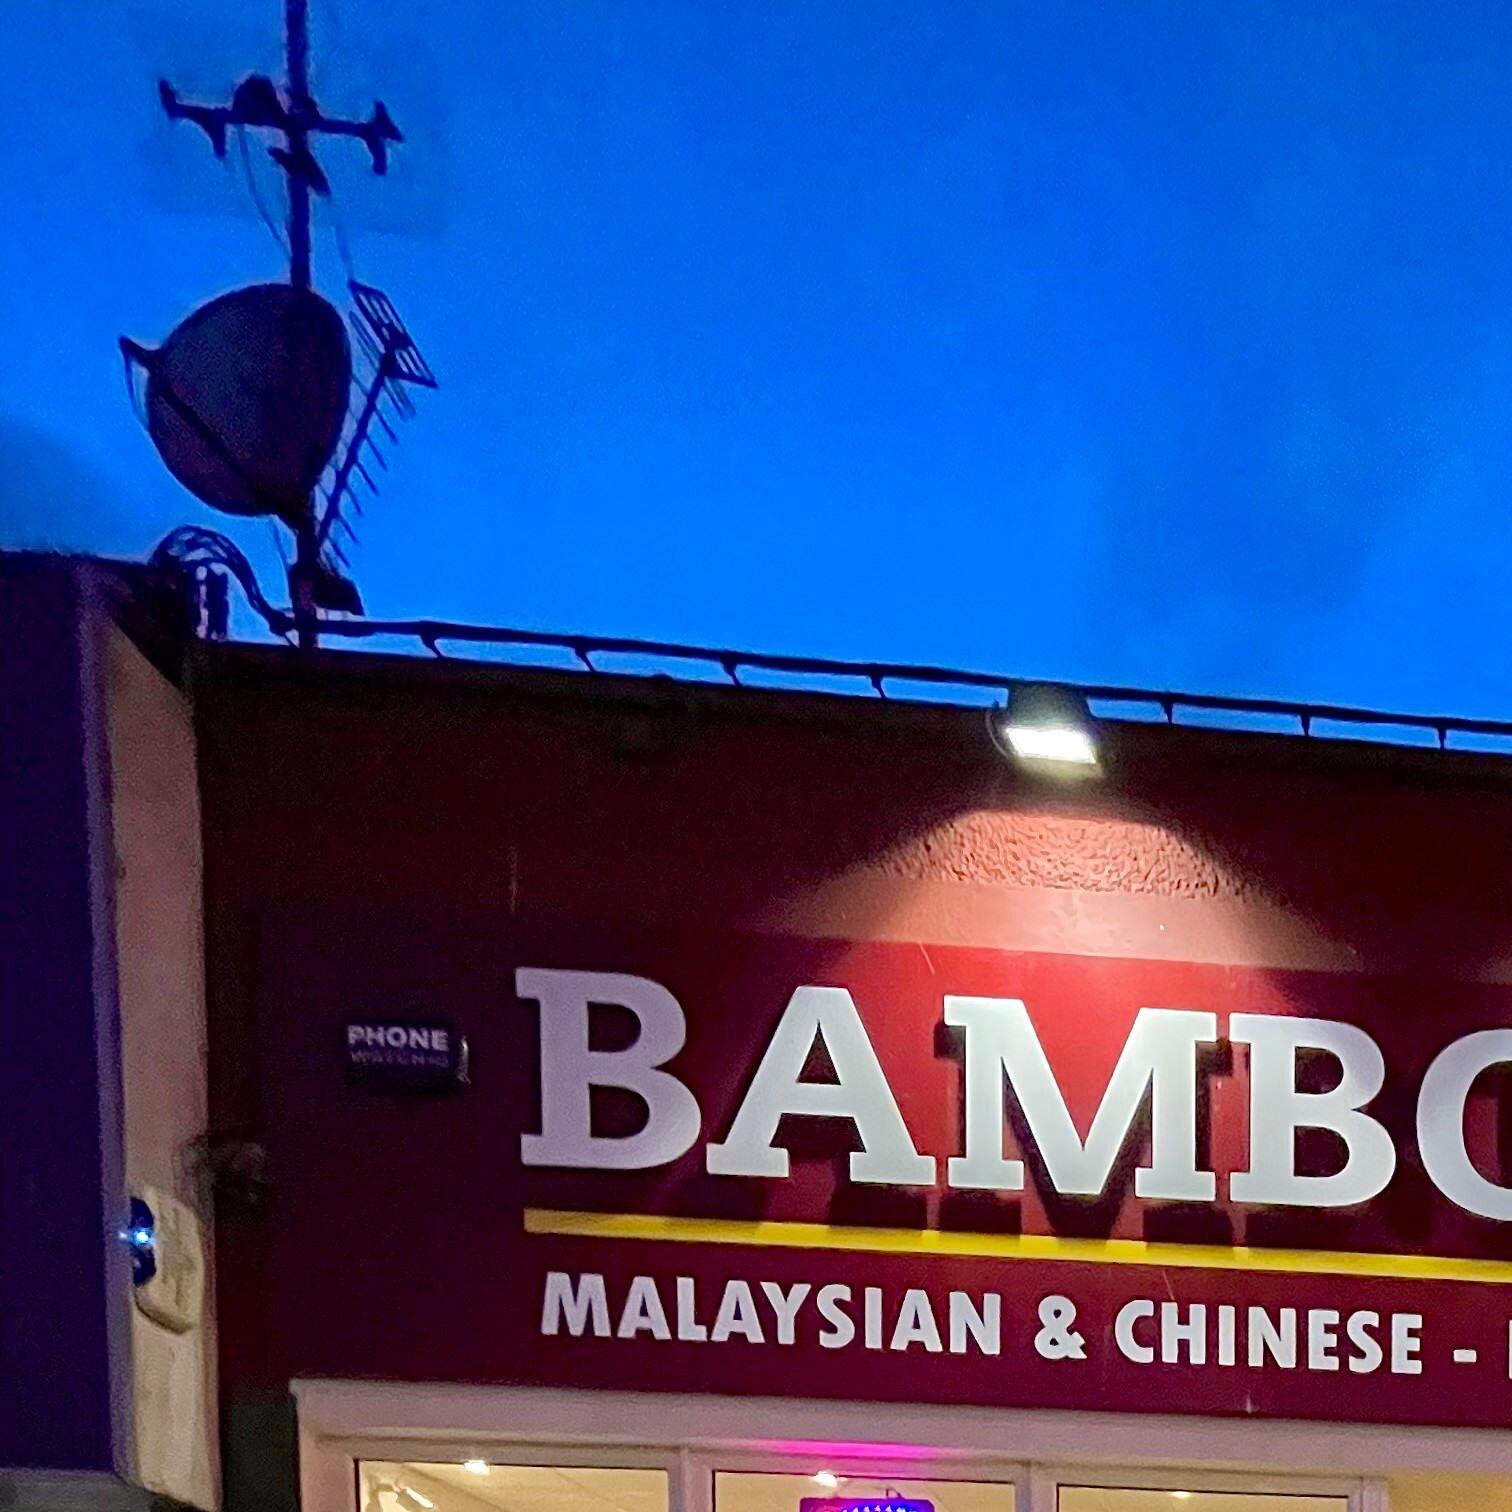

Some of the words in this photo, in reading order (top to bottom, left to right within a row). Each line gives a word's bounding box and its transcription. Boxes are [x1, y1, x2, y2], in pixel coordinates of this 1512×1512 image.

[347, 1024, 449, 1052] PHONE
[541, 1271, 1001, 1356] MALAYSIAN
[1033, 1294, 1088, 1361] &
[1114, 1299, 1423, 1376] CHINESE
